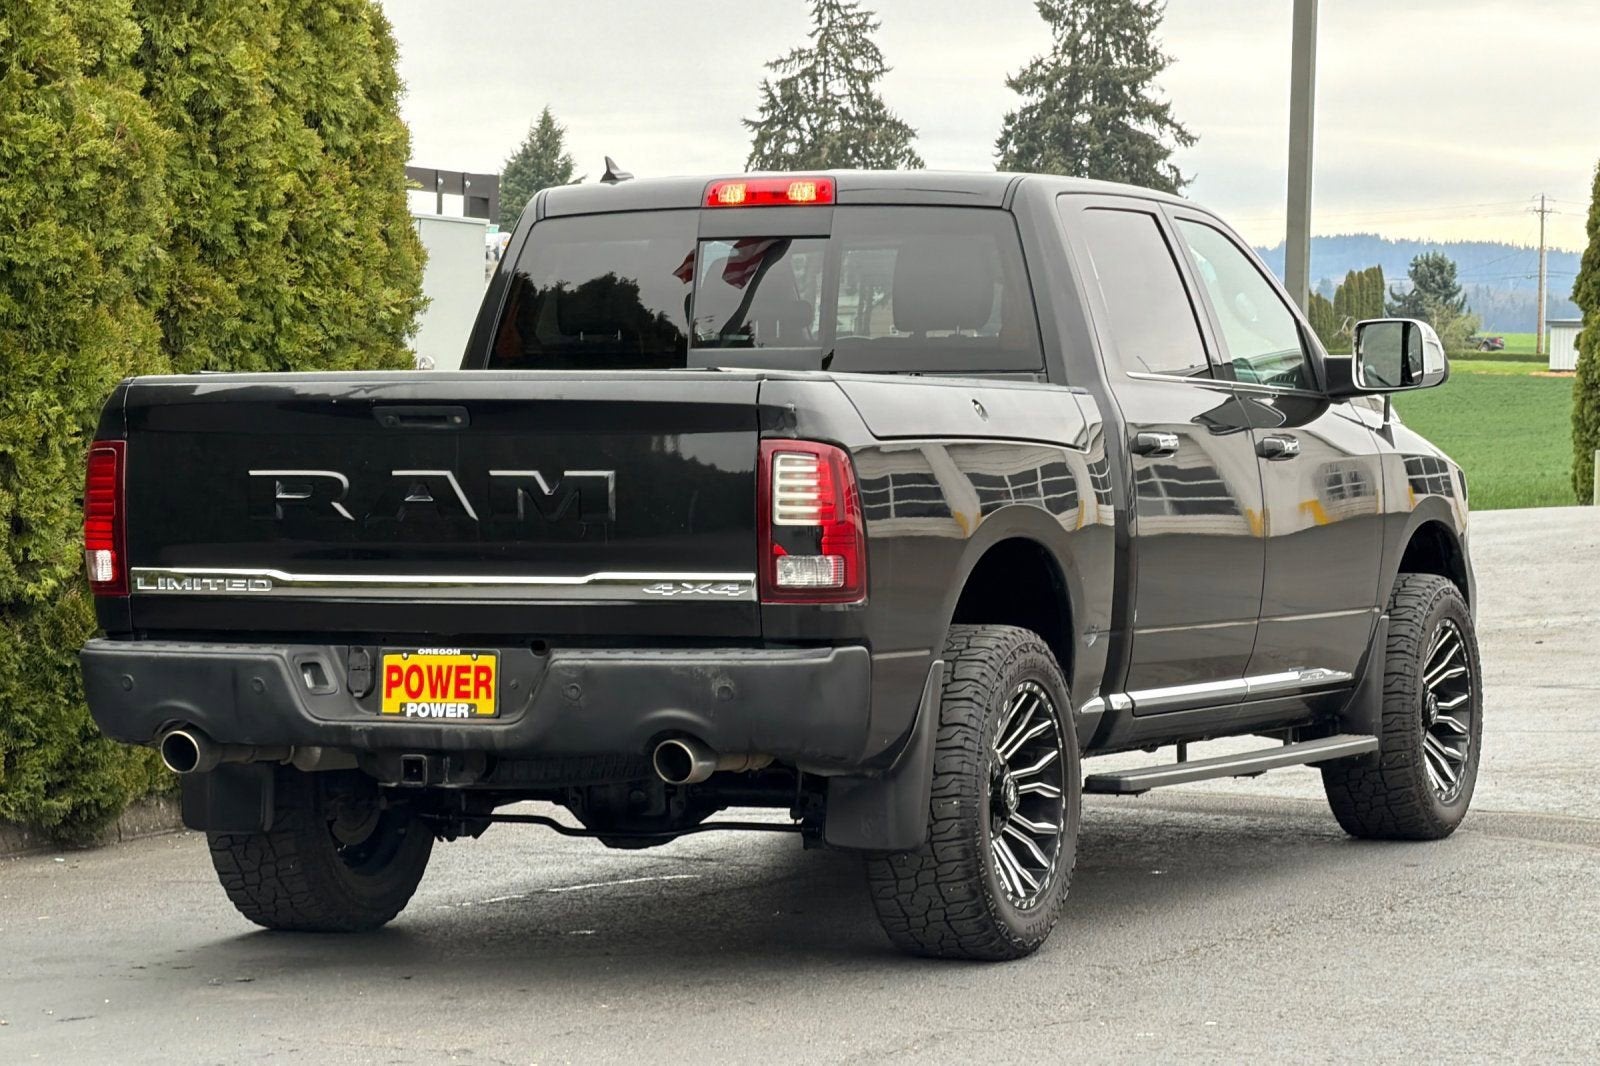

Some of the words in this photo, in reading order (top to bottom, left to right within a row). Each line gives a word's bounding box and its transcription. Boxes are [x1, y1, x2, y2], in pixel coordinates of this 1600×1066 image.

[248, 469, 616, 522] RAM
[136, 577, 273, 592] LIMITED
[417, 648, 461, 656] OREGON
[385, 664, 493, 700] POWER
[406, 702, 470, 718] POWER
